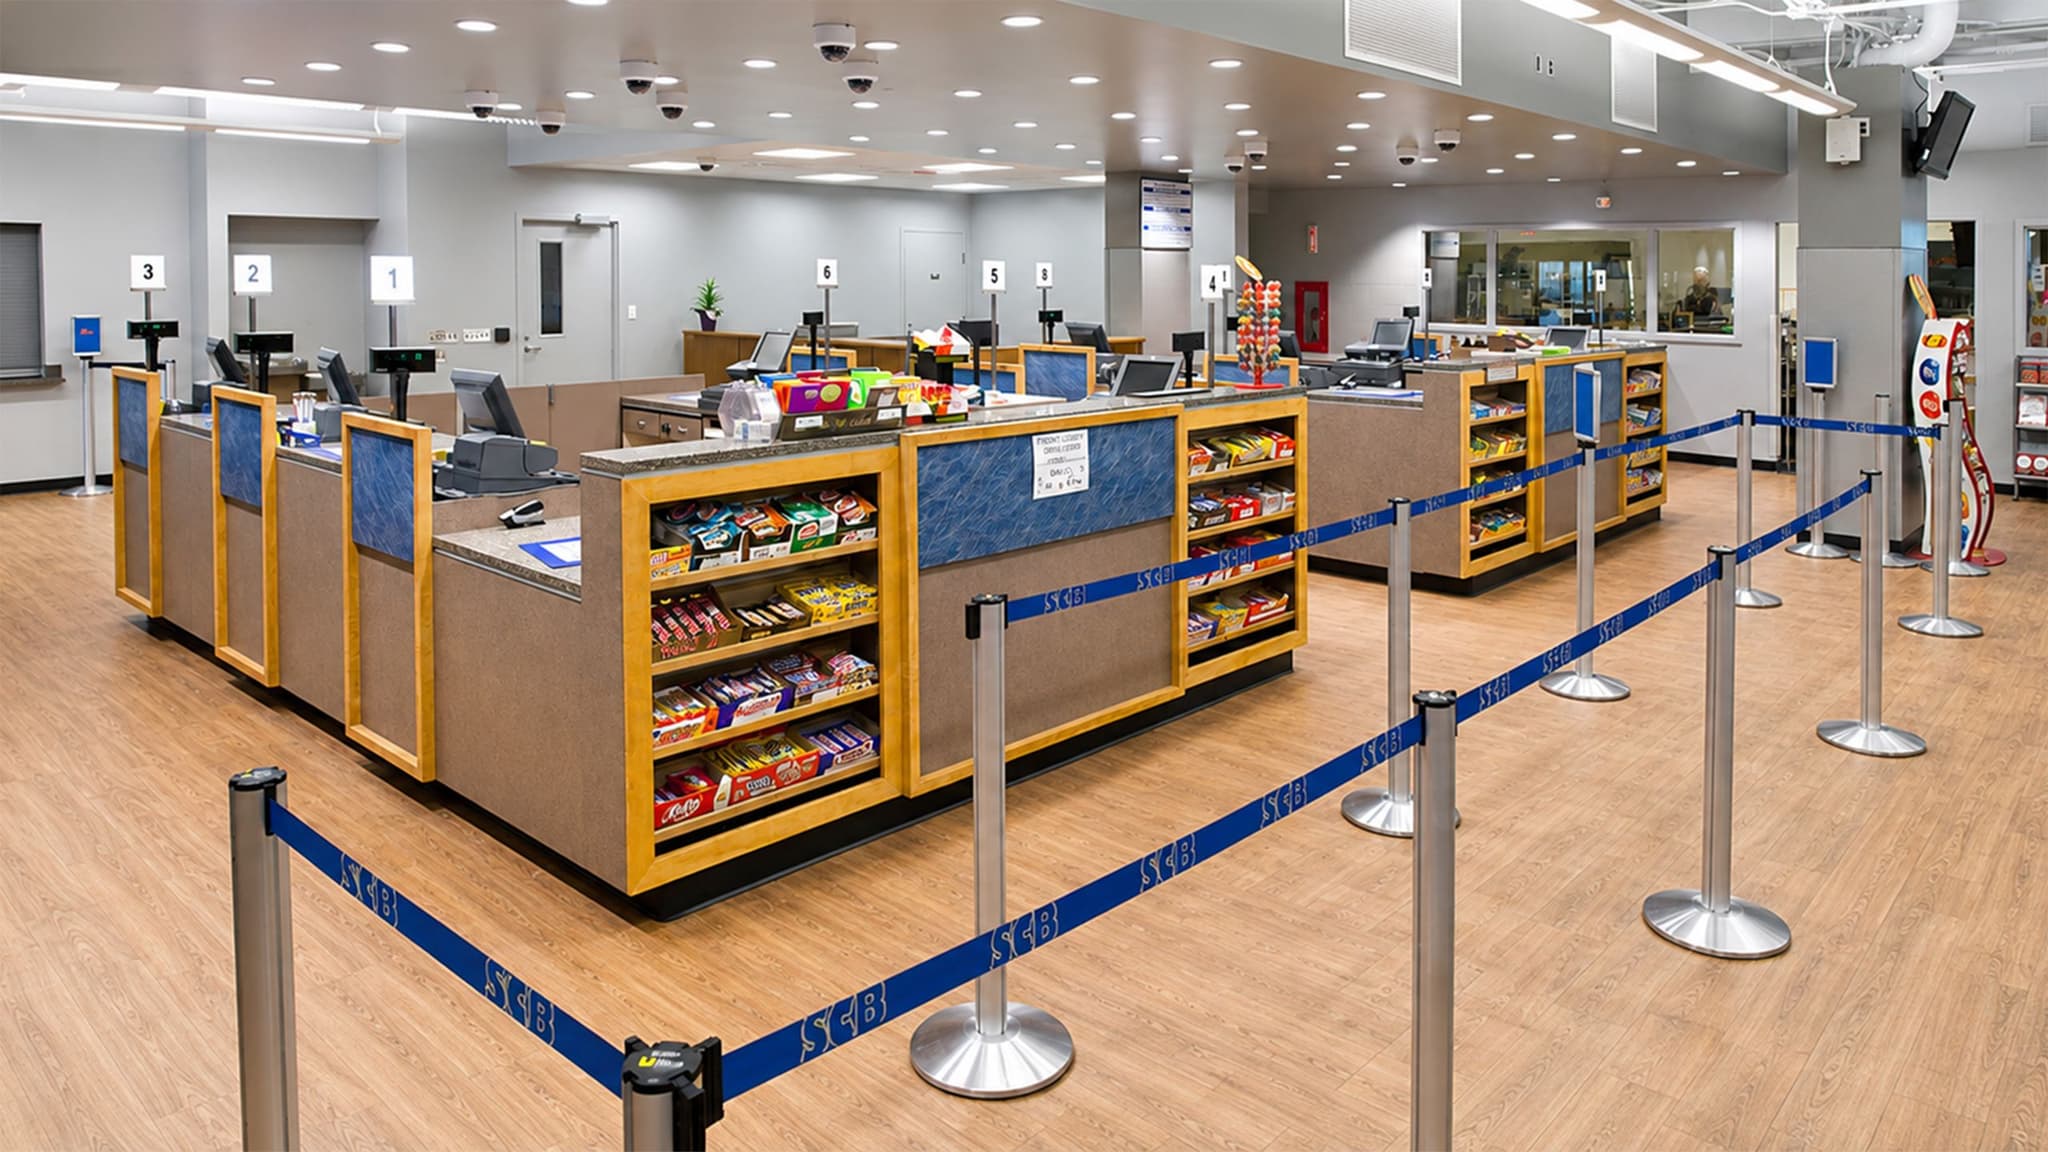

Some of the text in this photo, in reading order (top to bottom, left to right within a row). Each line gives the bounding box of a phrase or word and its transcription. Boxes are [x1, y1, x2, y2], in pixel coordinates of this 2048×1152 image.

[143, 263, 154, 280] 3
[247, 264, 259, 282] 2
[388, 267, 397, 289] 1
[823, 265, 832, 280] 6
[991, 268, 999, 284] 5
[1209, 275, 1216, 293] 4
[1140, 832, 1196, 893] SCB
[989, 901, 1059, 970] SCB
[801, 981, 887, 1063] SCB
